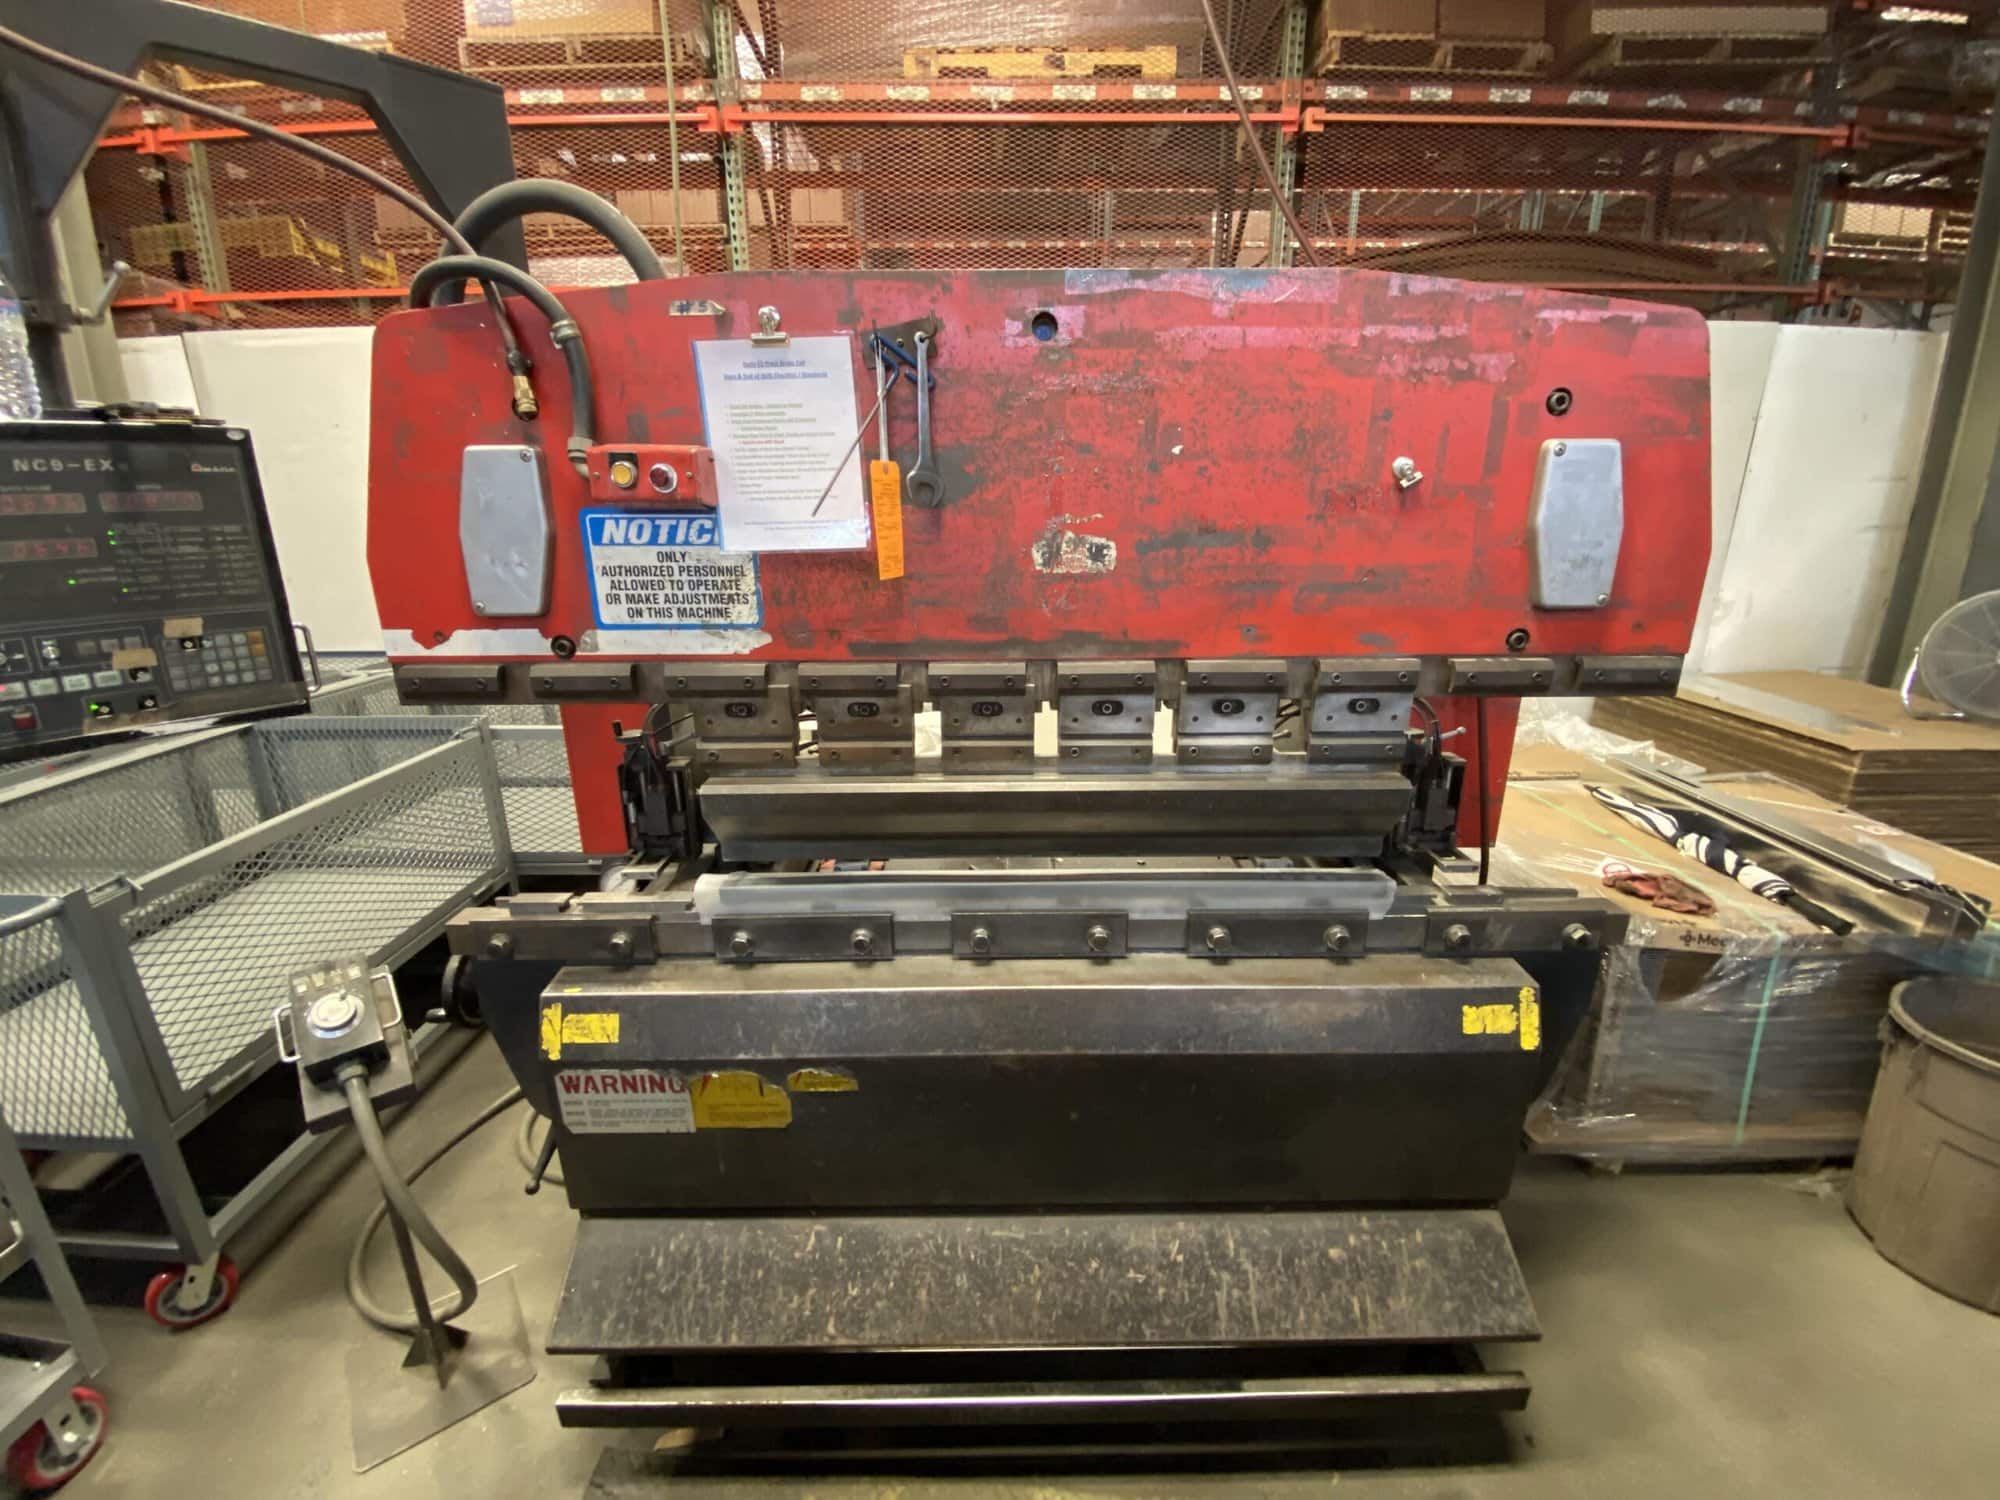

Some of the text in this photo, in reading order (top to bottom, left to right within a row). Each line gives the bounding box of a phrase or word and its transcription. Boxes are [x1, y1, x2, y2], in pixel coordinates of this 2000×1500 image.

[602, 518, 719, 545] NOTIC
[657, 551, 687, 563] ONLY
[602, 565, 747, 577] AUTHORIZED PERSONNEL
[610, 579, 742, 591] ALLOWED TO OPERATE
[606, 593, 749, 605] OR MAKE ADJUSTMENTS
[627, 606, 731, 619] ON THIS MACHINE
